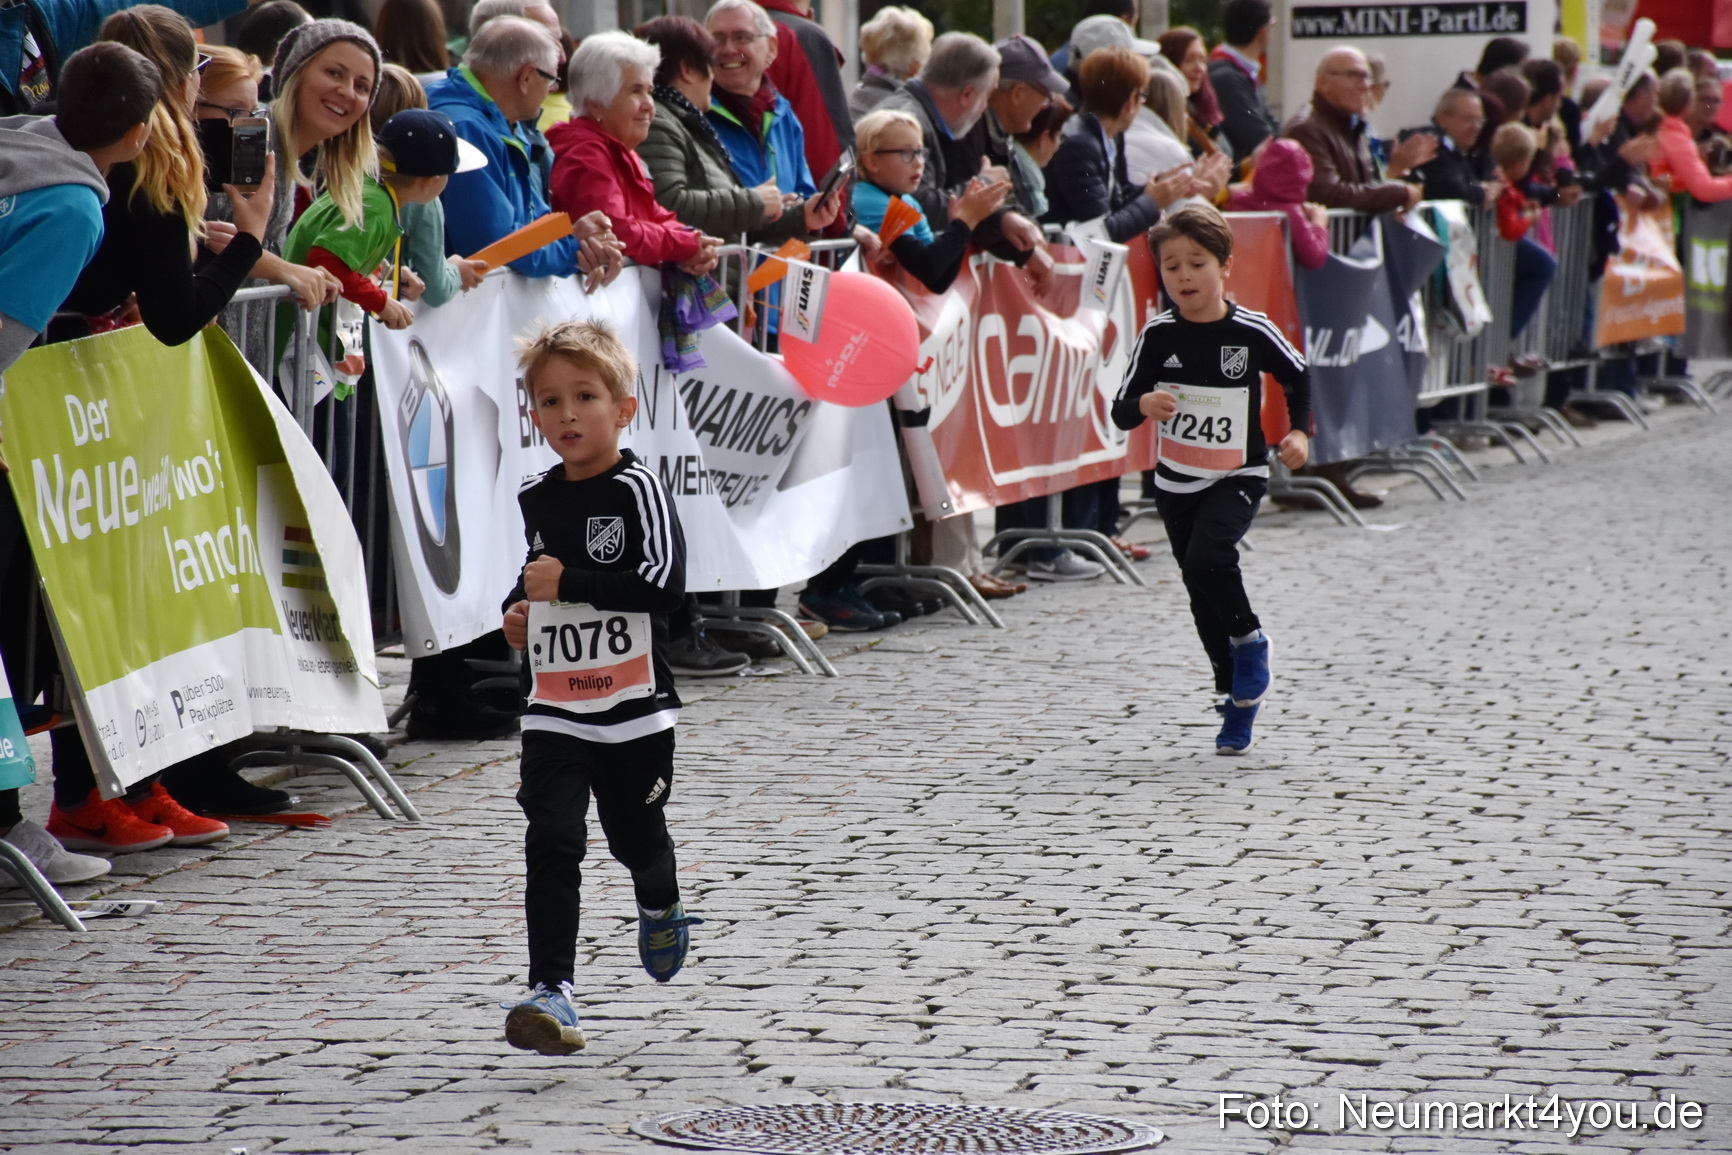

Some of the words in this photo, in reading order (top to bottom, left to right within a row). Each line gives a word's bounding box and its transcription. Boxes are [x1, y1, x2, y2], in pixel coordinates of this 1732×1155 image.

[798, 267, 813, 311] swn
[1229, 356, 1247, 377] TSV
[64, 394, 111, 447] Der
[31, 453, 139, 549] Neue
[598, 527, 622, 560] TSV
[541, 615, 632, 663] 7078
[182, 683, 204, 702] über
[204, 674, 225, 694] 500
[568, 675, 613, 692] Philipp
[188, 697, 235, 725] Parkplätze
